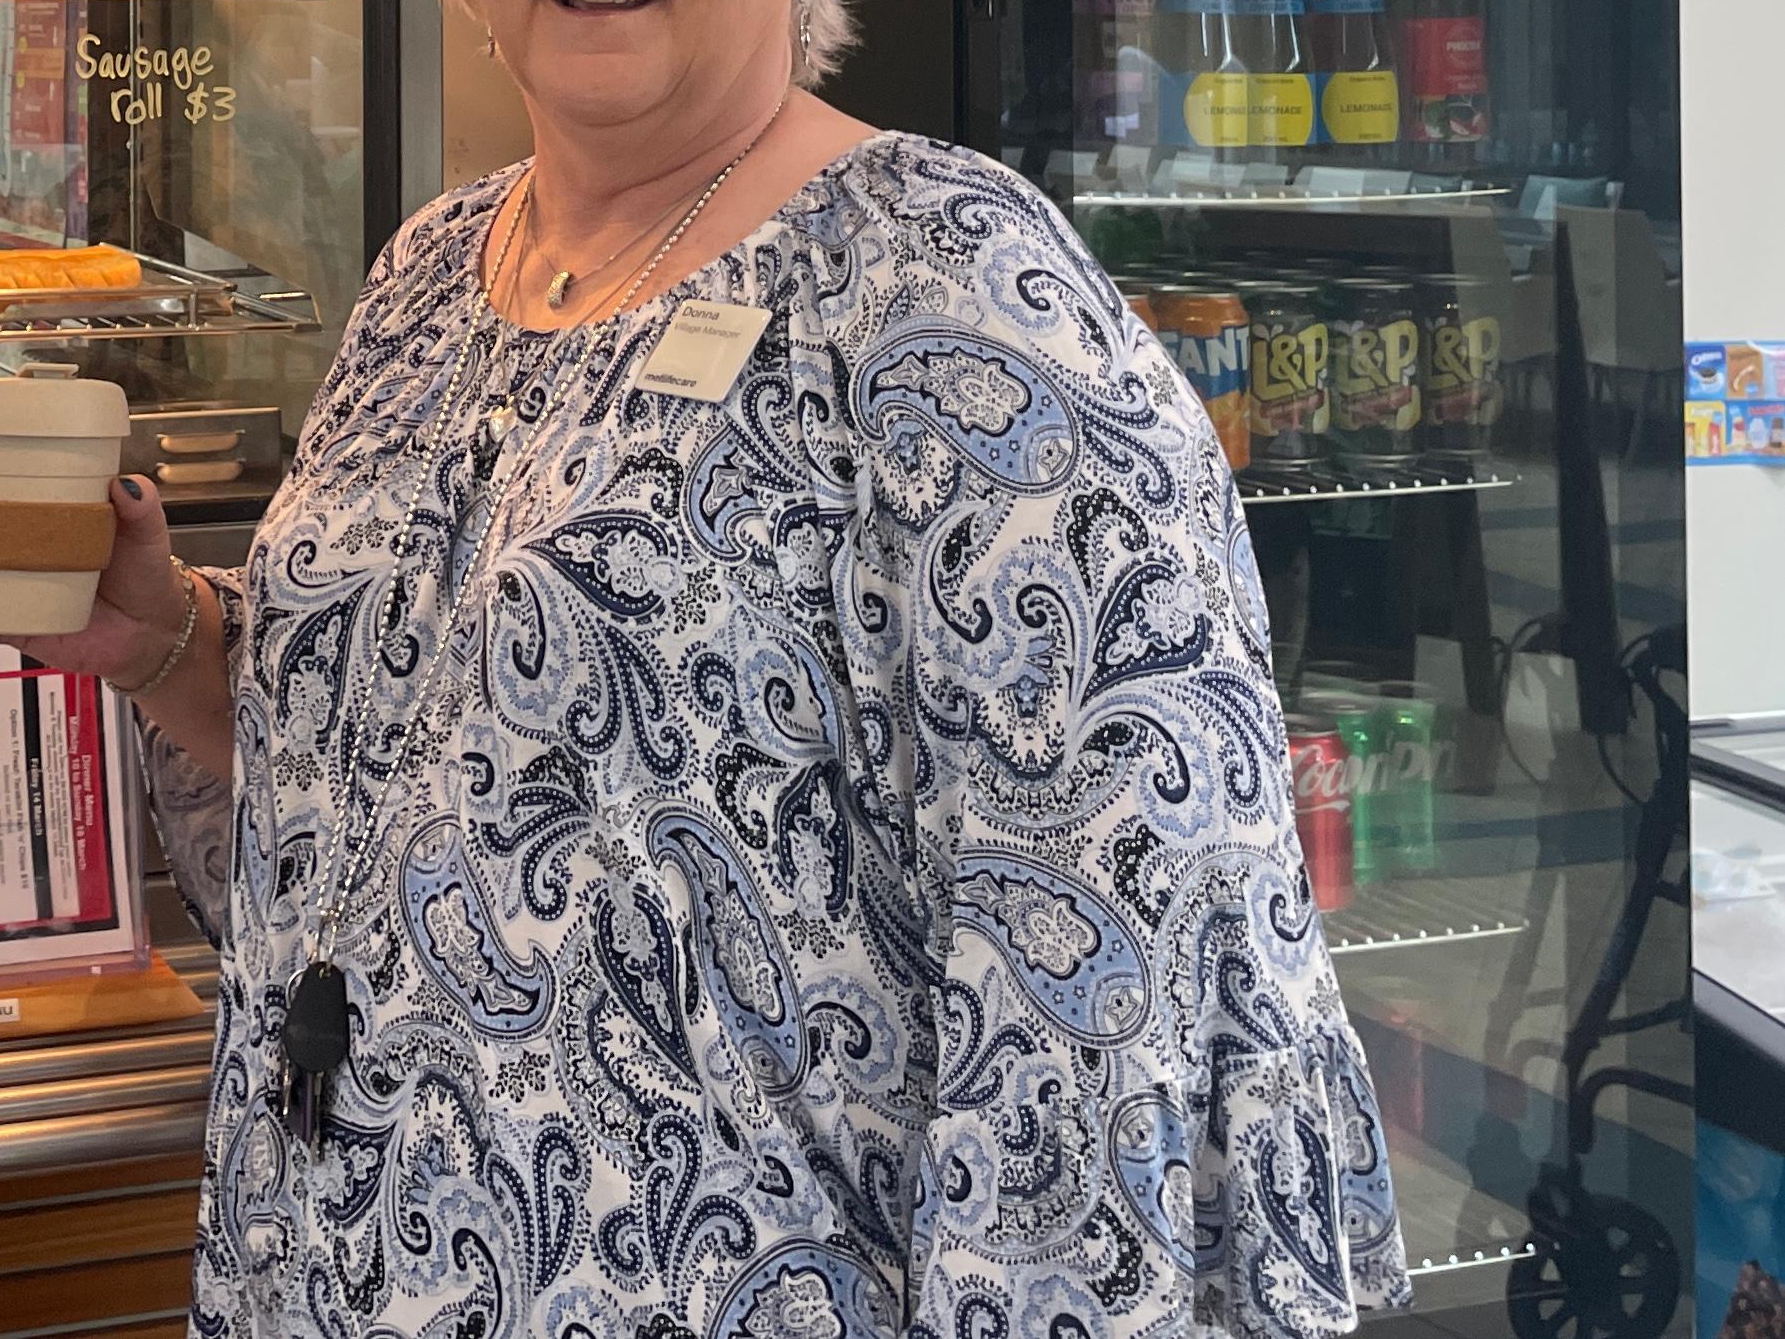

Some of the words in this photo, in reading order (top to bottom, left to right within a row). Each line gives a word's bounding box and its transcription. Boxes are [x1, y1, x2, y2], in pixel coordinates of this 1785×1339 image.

[75, 34, 214, 90] Sausage
[111, 82, 162, 125] roll
[184, 82, 237, 125] $3
